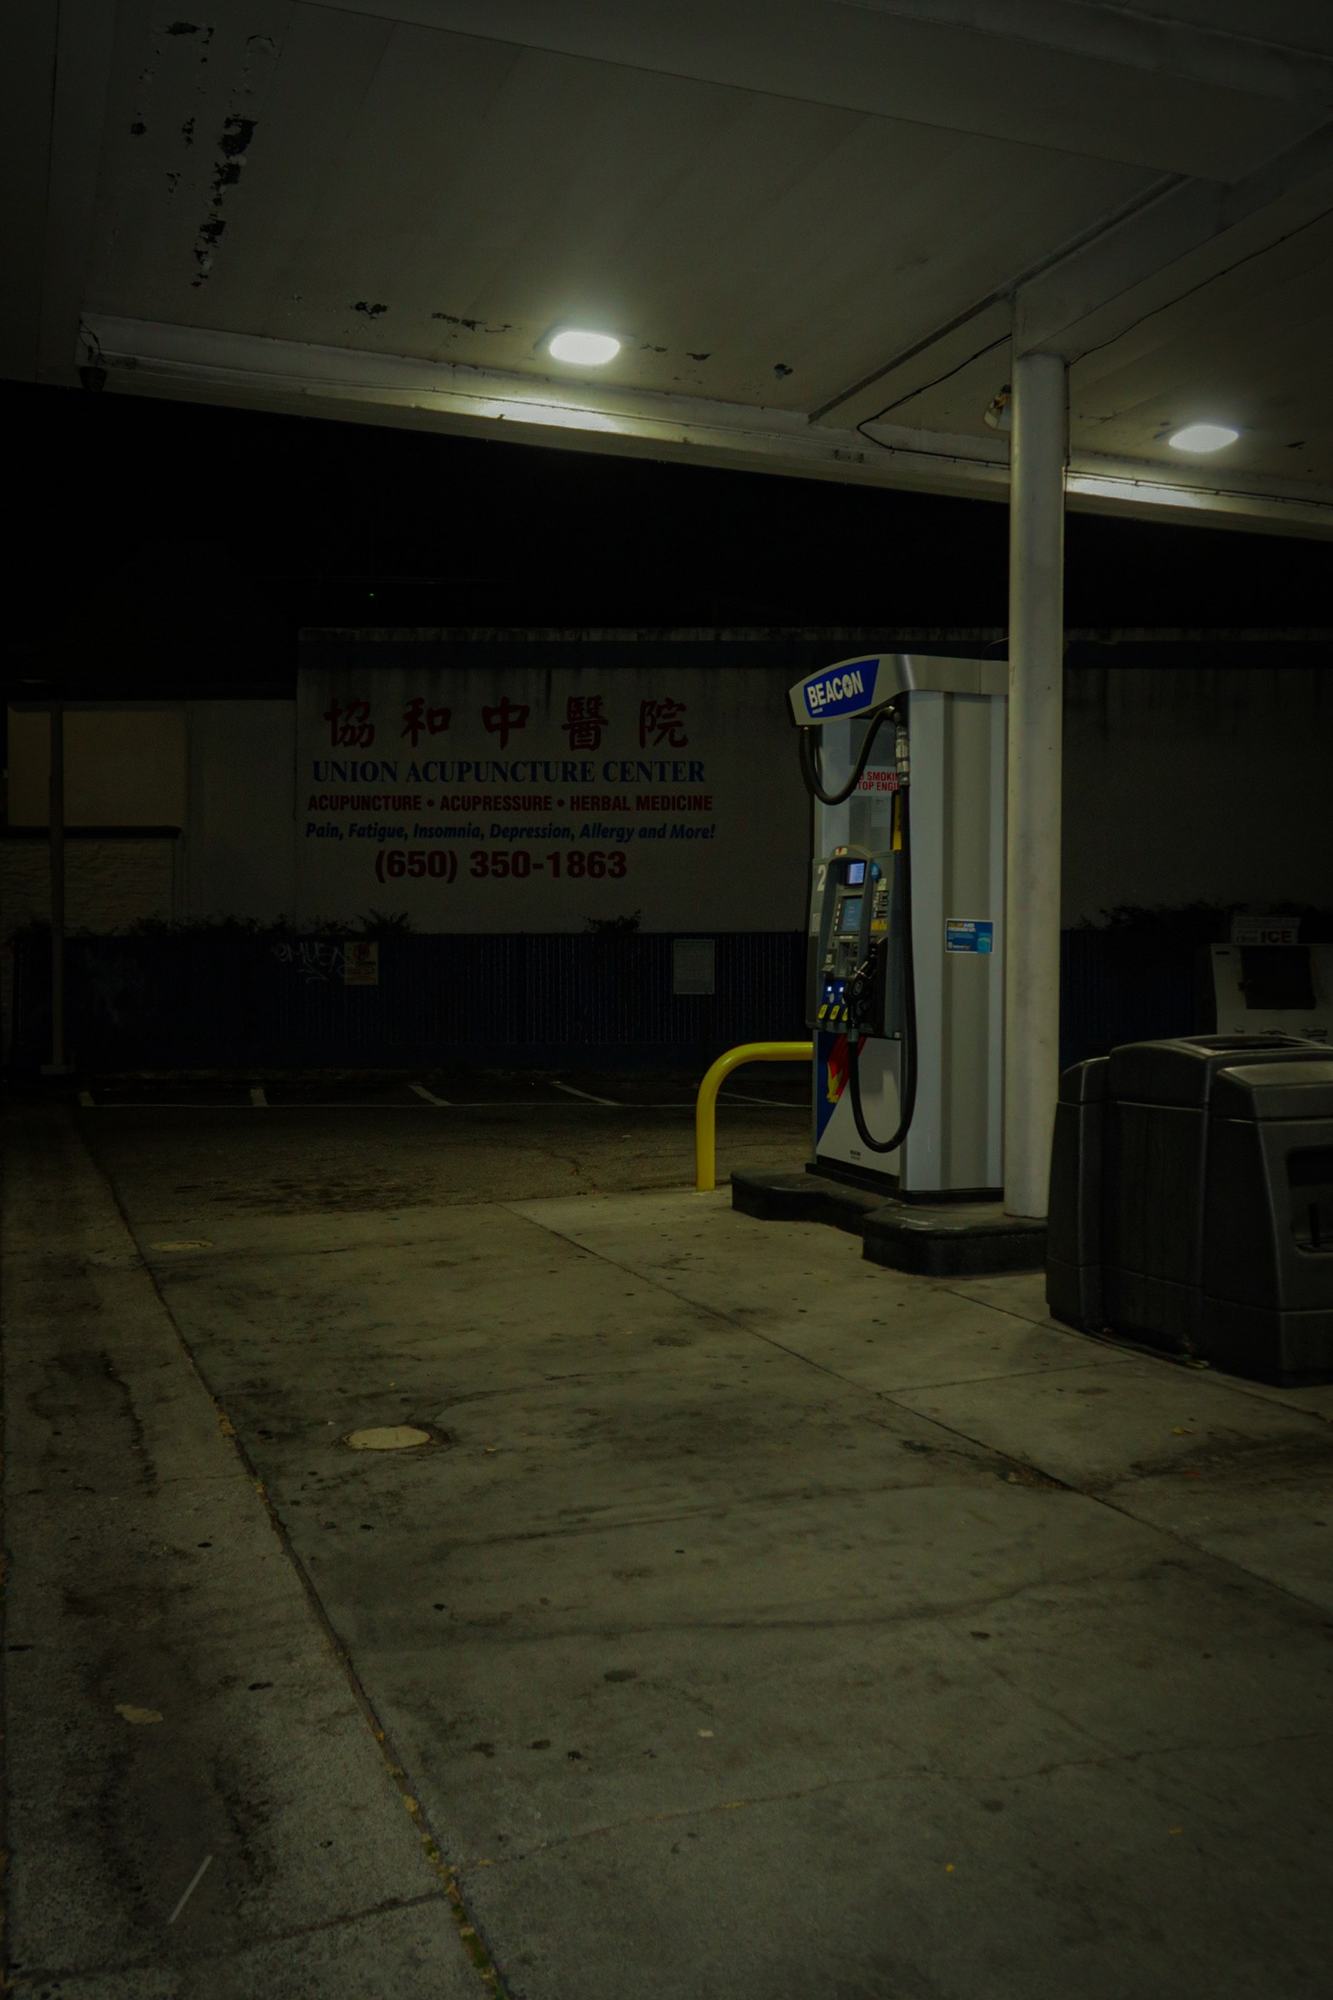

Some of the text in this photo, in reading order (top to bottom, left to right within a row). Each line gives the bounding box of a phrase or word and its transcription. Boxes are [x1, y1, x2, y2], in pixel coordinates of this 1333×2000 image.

[806, 670, 864, 708] BEACON
[323, 695, 688, 750] 協和中醫院
[313, 761, 704, 782] UNION ACUPUNCTURE CENTER
[857, 781, 874, 791] TOP
[307, 795, 712, 811] ACUPUNCTURE ACUPRESSURE HERBAL MEDICINE
[306, 822, 715, 843] Pain, Fatigue, Insomnia, Depression, Allergy and More!
[375, 850, 627, 884] (650) 350-1863
[817, 864, 826, 892] 2
[1260, 930, 1293, 943] ICE
